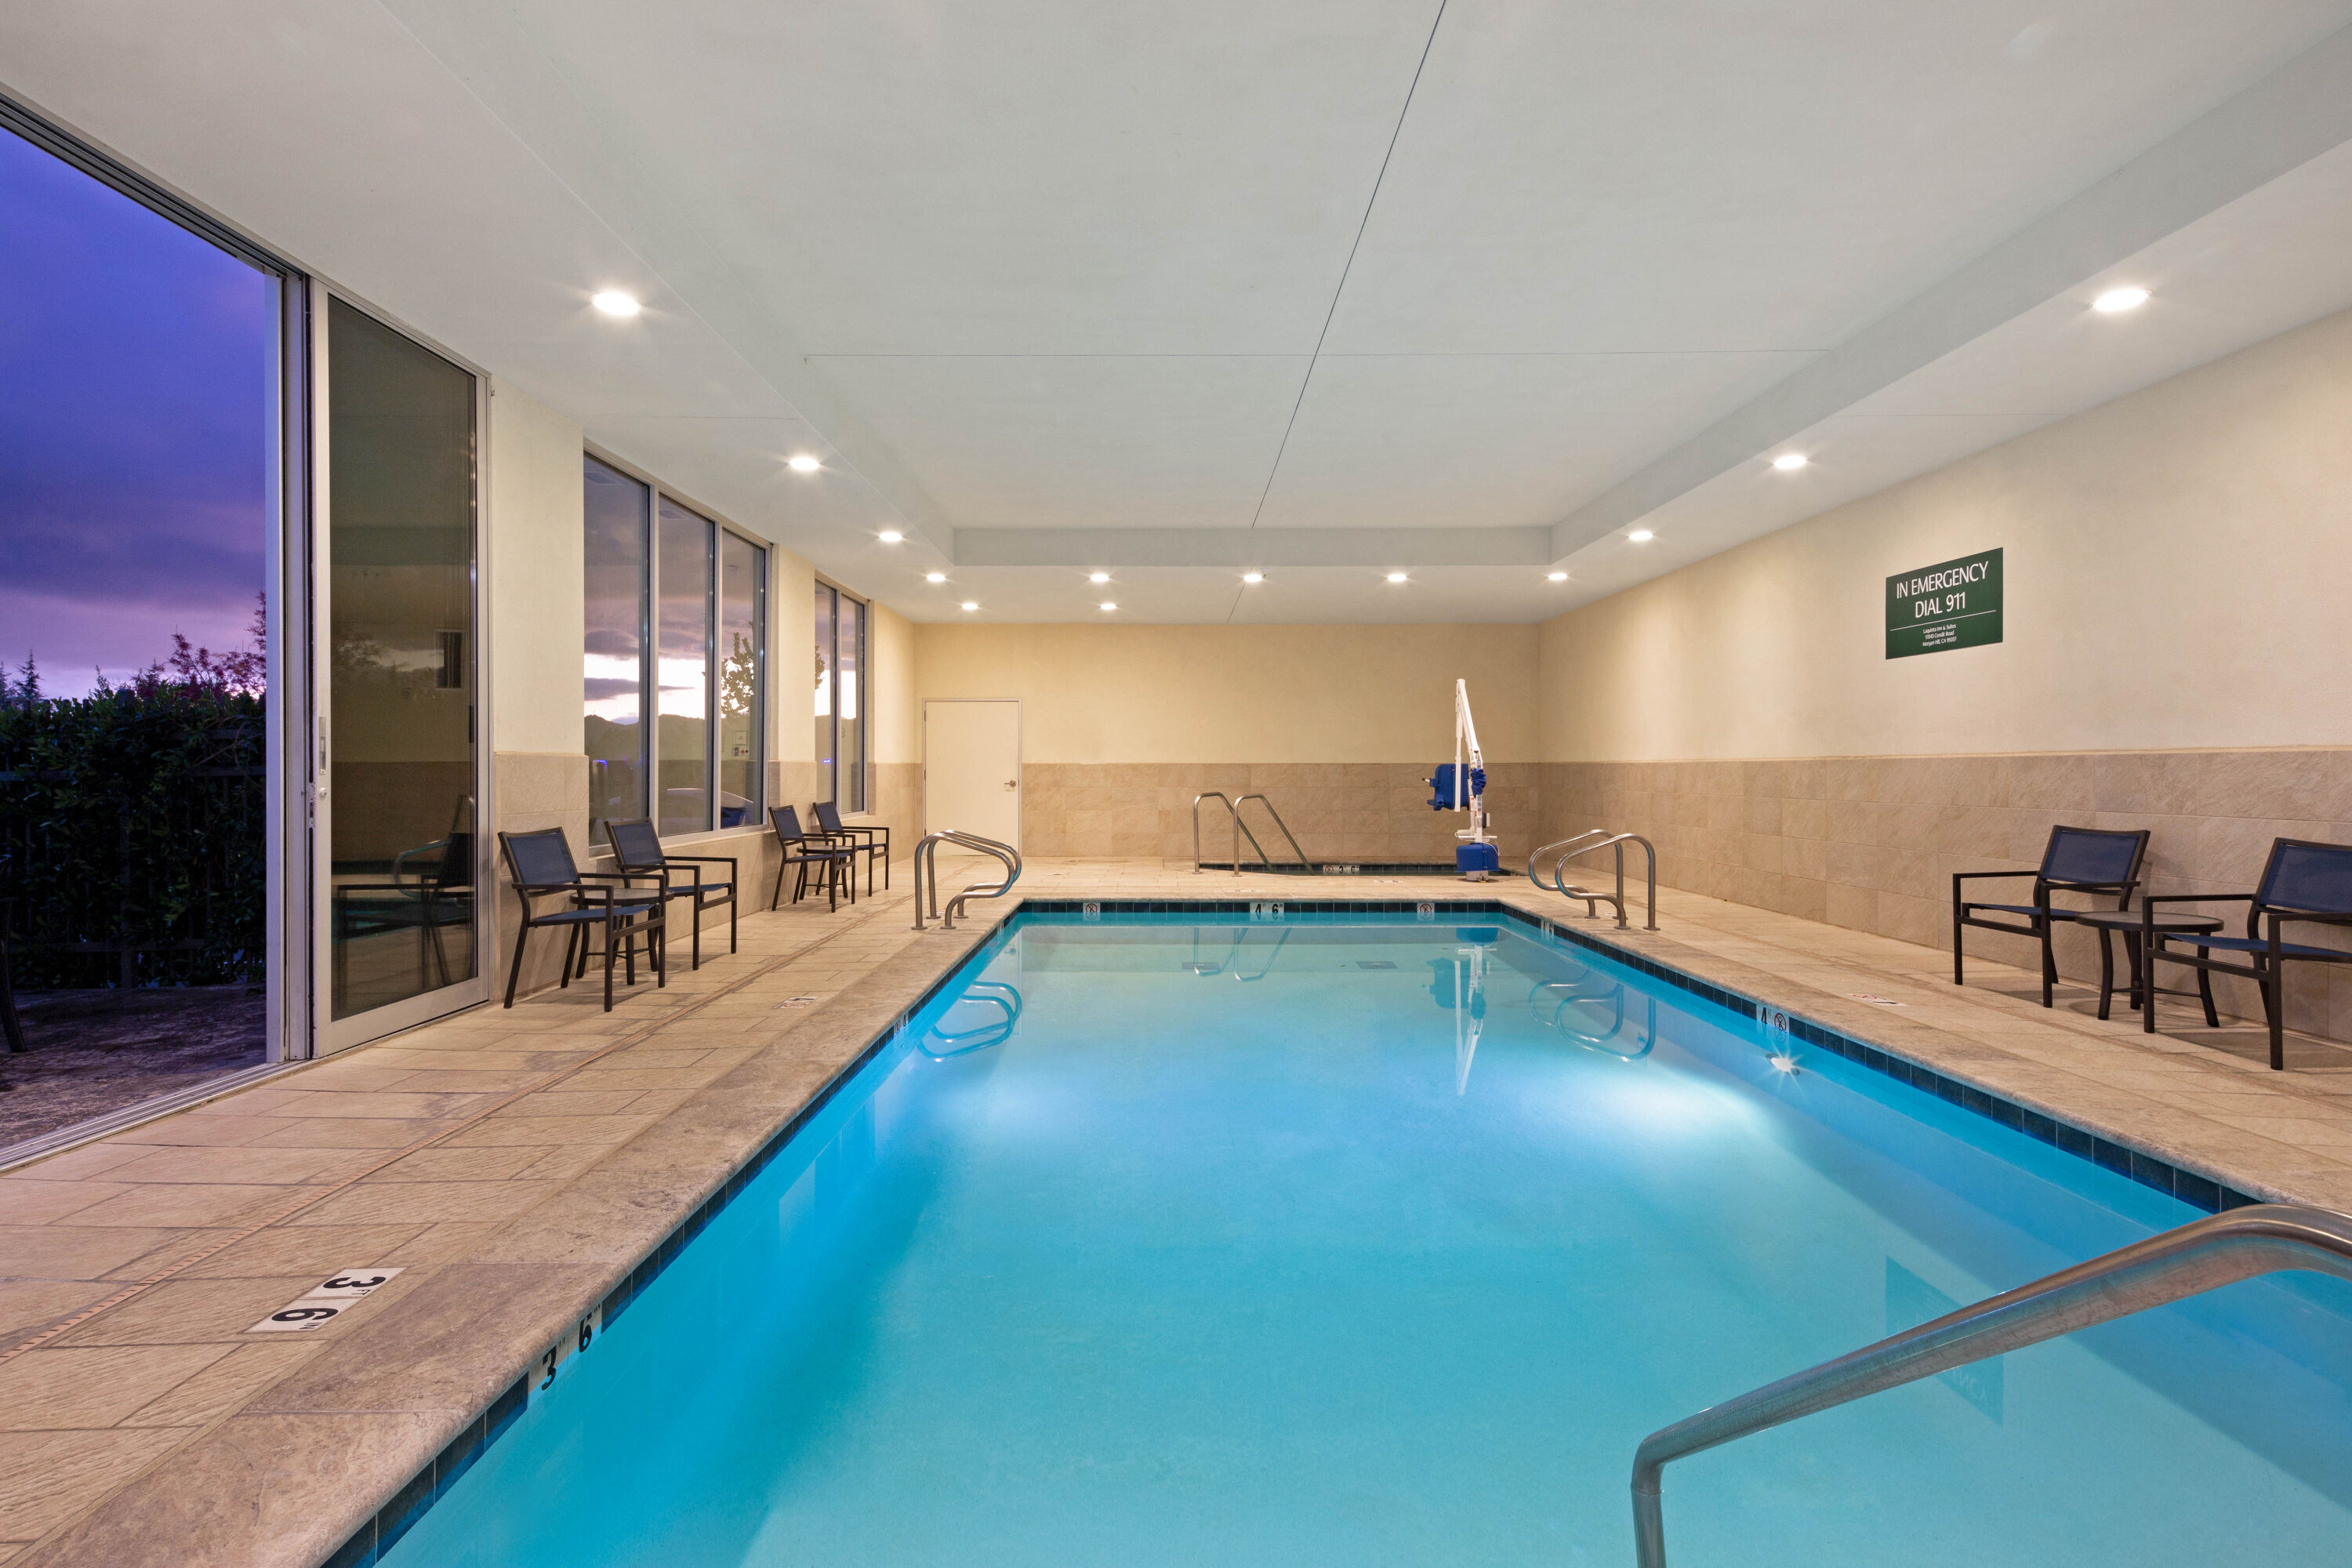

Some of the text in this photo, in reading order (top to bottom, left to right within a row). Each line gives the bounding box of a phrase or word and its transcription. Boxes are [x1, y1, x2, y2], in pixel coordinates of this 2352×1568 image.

[1896, 561, 1989, 599] IN EMERGENCY
[1915, 591, 1965, 619] DIAL 911
[323, 1276, 386, 1289] 3
[271, 1308, 339, 1322] 6
[541, 1312, 592, 1391] 3 6
